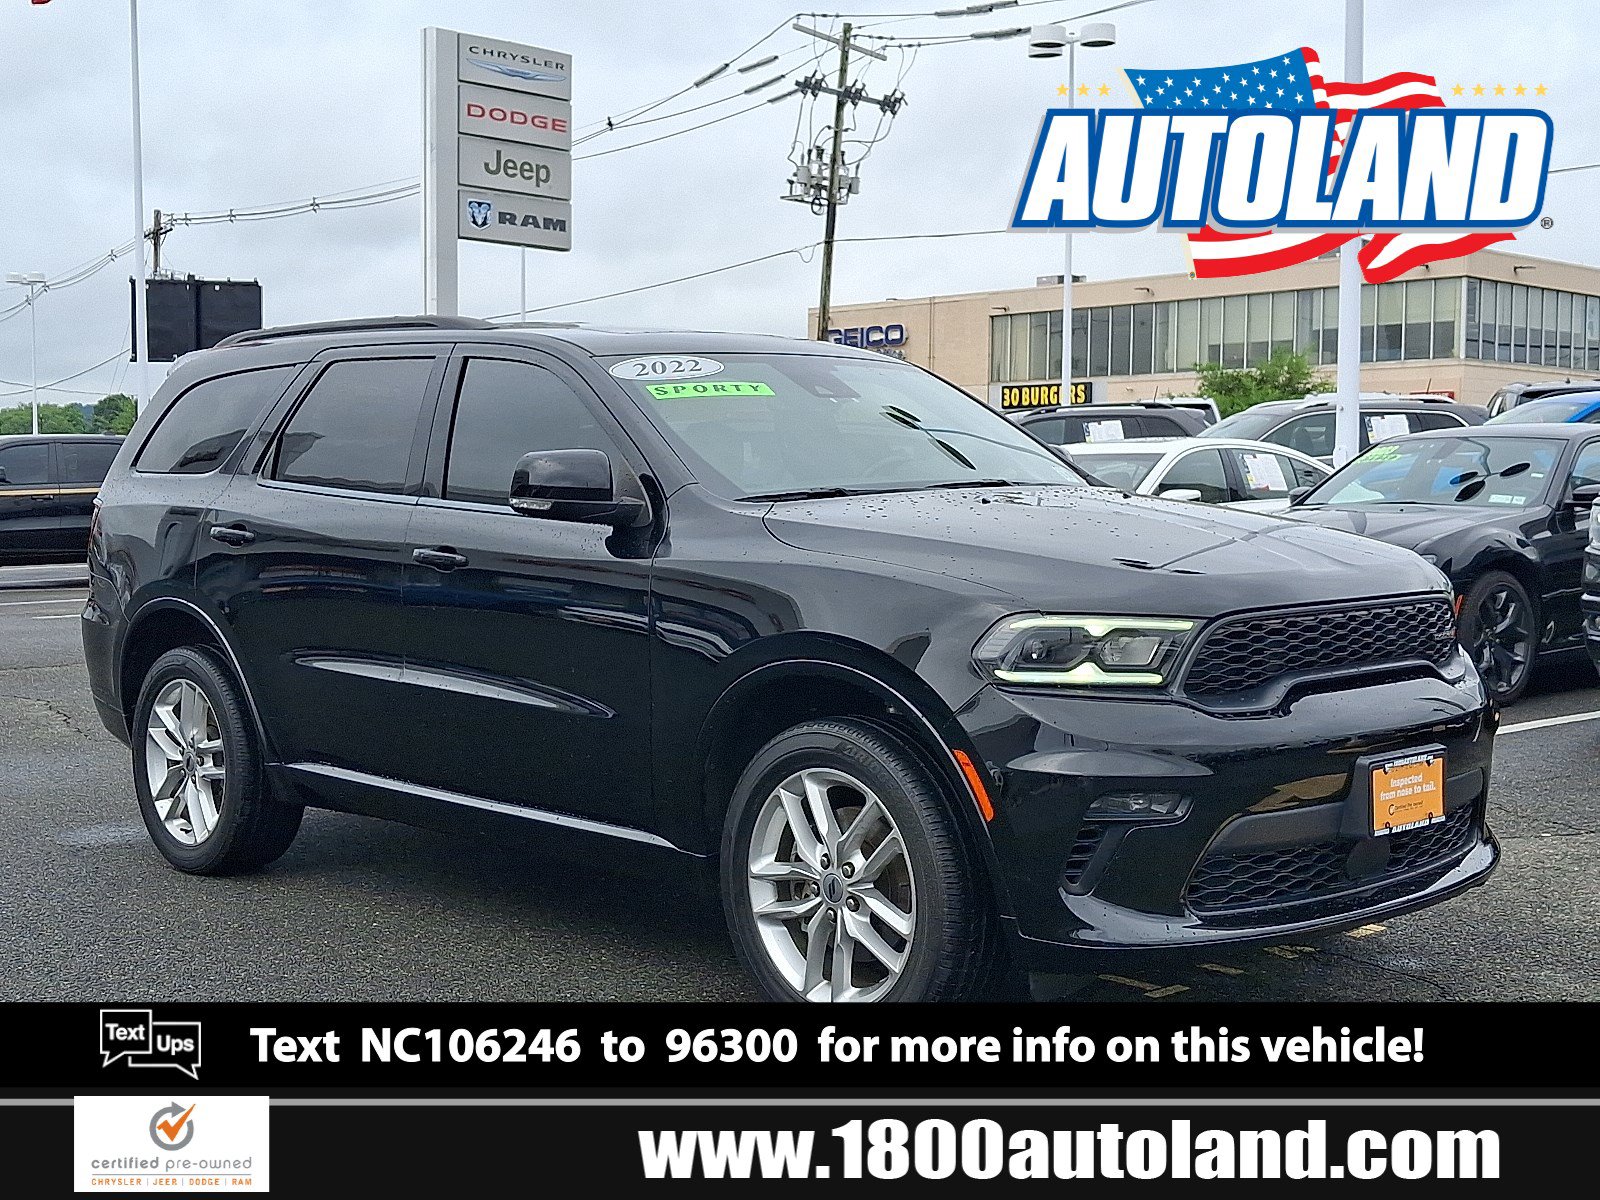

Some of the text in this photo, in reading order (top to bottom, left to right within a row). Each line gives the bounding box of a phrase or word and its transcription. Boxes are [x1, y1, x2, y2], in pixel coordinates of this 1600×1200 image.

[468, 46, 566, 71] CHRYSLER
[466, 103, 568, 133] DODGE
[483, 149, 551, 188] Jeep
[498, 211, 567, 233] RAM
[633, 359, 703, 377] 2022
[654, 383, 762, 396] SPORTY
[1003, 384, 1086, 406] 30 BURGRS
[1390, 773, 1423, 789] Inspected
[1380, 790, 1396, 801] from
[1397, 787, 1412, 798] nose
[1413, 784, 1422, 794] to
[1391, 818, 1430, 834] AUTOLAND
